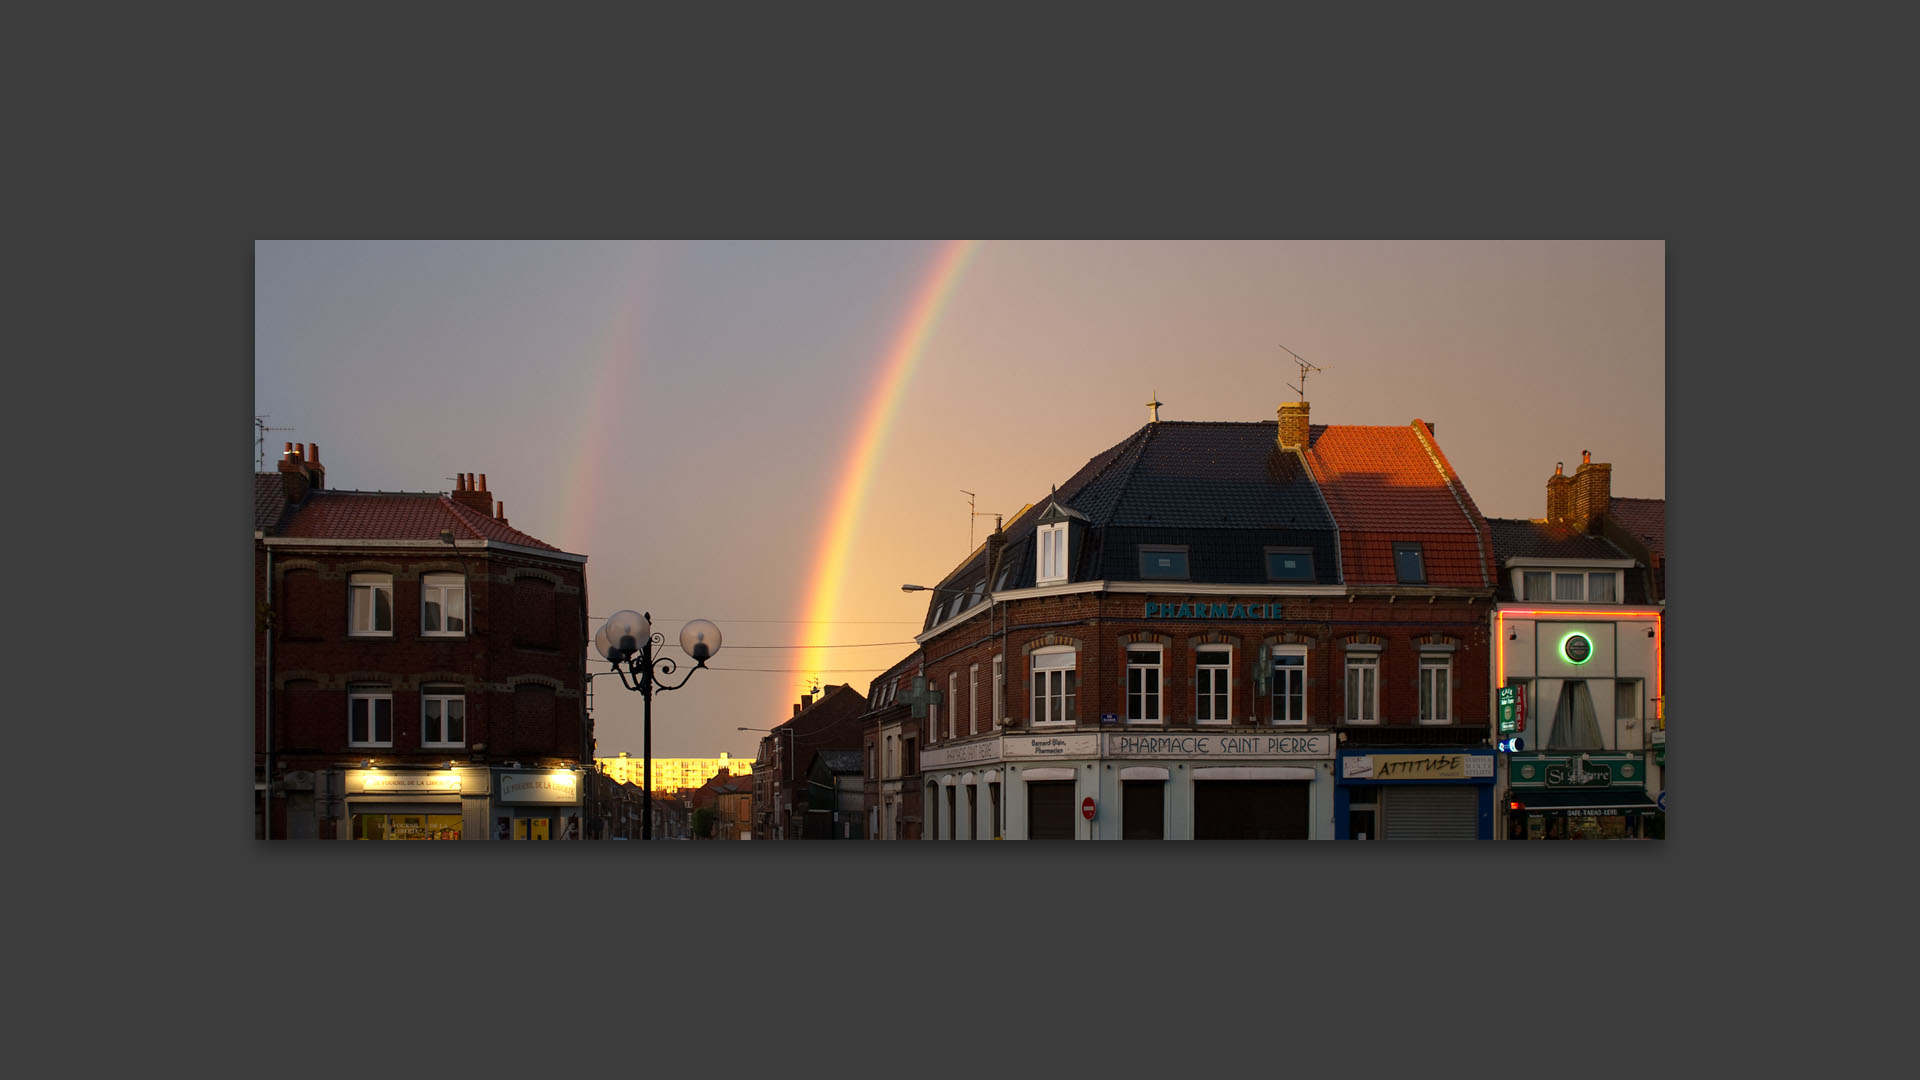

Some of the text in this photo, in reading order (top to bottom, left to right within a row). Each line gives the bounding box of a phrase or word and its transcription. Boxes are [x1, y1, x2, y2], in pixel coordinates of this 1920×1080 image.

[1145, 602, 1283, 618] PHARMACIE
[1121, 737, 1319, 753] PHARMACIE SAINT PIERRE
[1377, 756, 1462, 778] ATTITUDE
